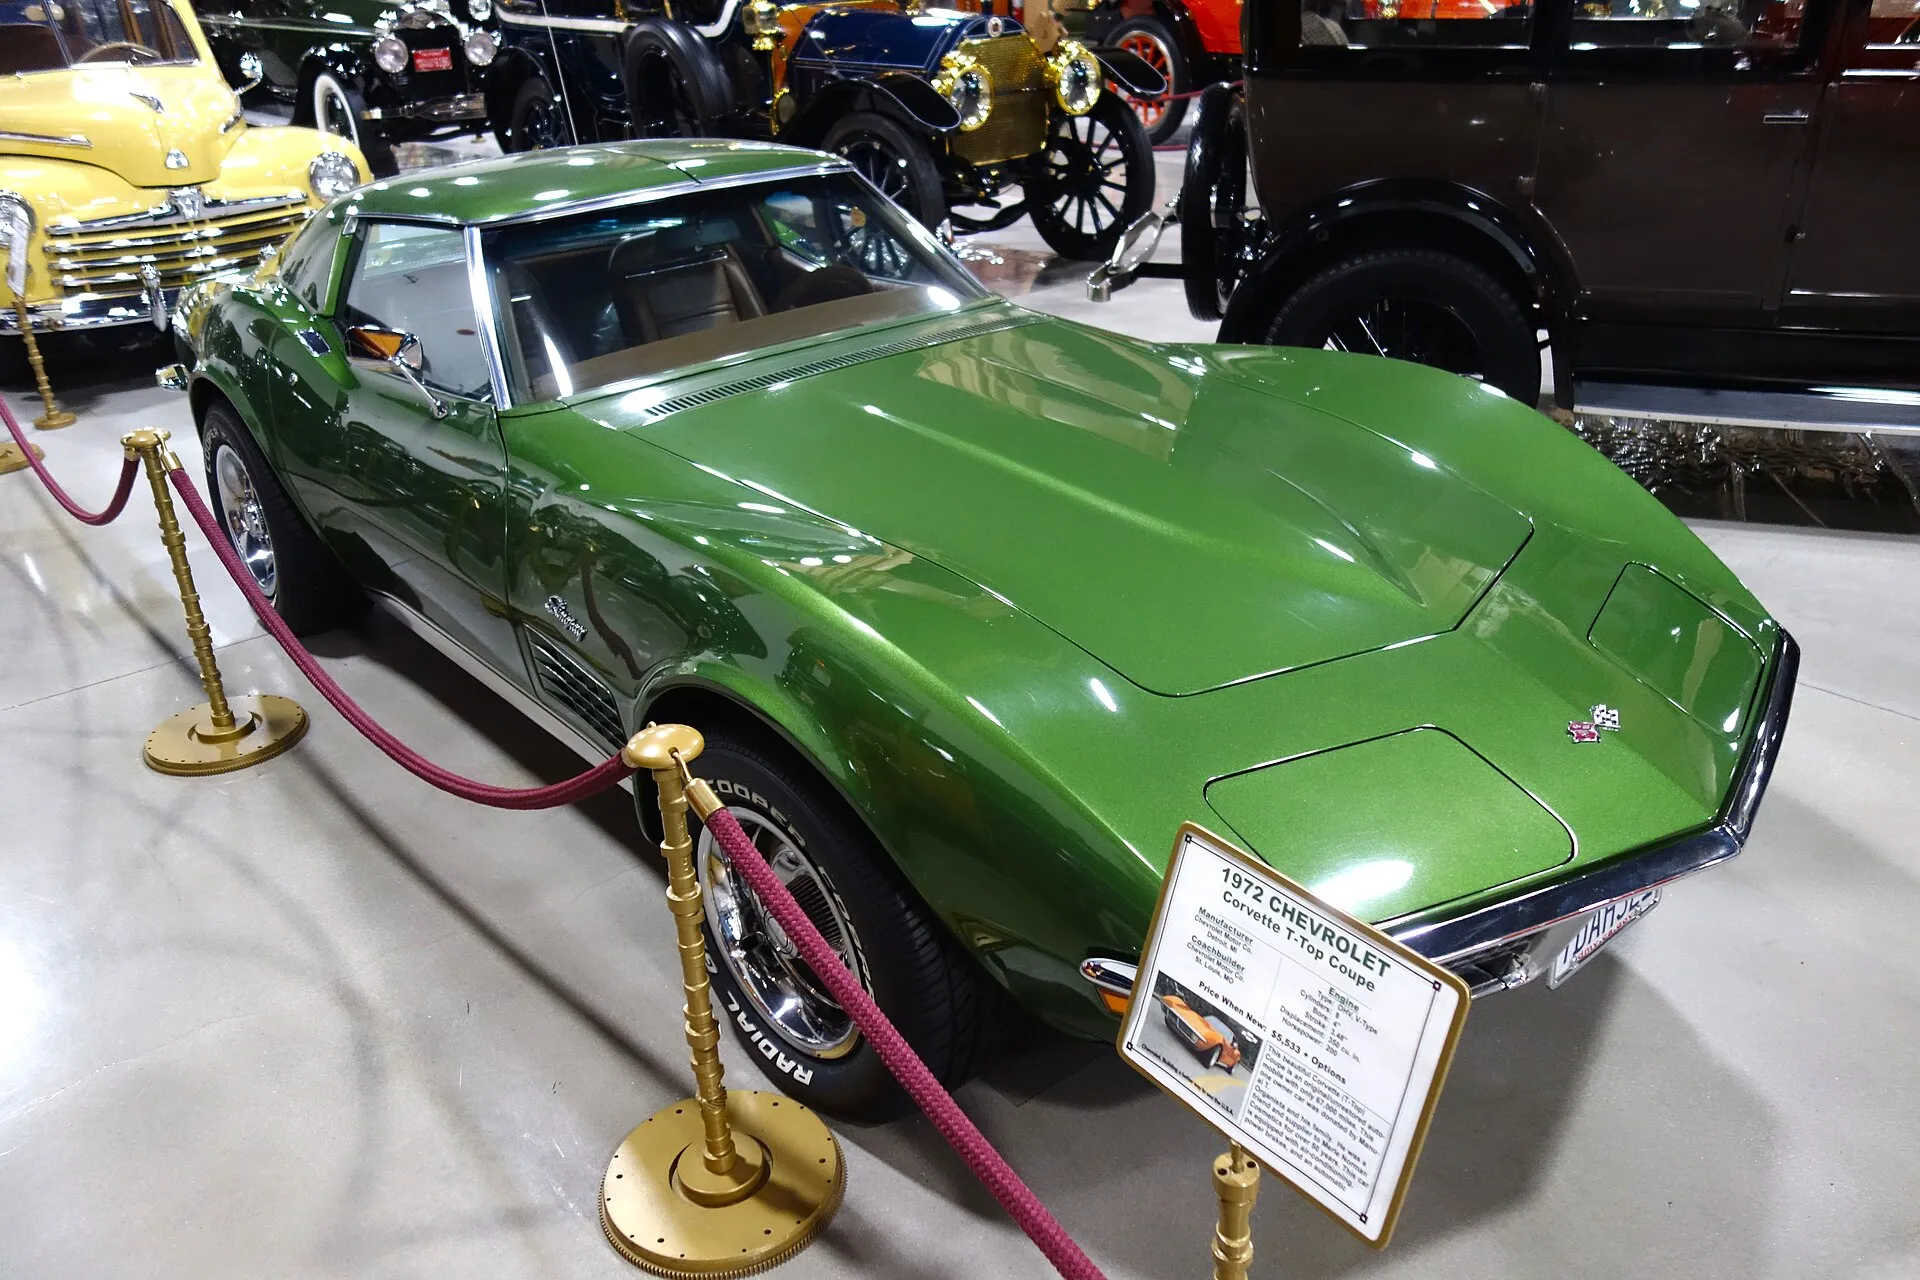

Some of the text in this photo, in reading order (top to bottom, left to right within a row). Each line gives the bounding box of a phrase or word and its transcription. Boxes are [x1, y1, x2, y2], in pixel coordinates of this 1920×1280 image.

[1194, 914, 1223, 936] Chevrolet
[1223, 931, 1241, 946] Motor
[1198, 906, 1253, 944] Manufacturer
[1221, 866, 1391, 977] 1972 CHEVROLET
[1222, 890, 1375, 992] Corvette T-Top Coupe
[1186, 941, 1215, 964] Chevrolet
[1215, 959, 1233, 974] Motor
[1191, 934, 1245, 972] Coachbuilder
[1328, 986, 1359, 1012] Engine
[1354, 1014, 1378, 1035] V-Type
[727, 990, 814, 1086] RADIAL
[1198, 980, 1220, 999] Price
[1221, 995, 1244, 1016] When
[1245, 1011, 1267, 1032] New:
[1270, 1029, 1301, 1054] $5,533
[1310, 1055, 1346, 1085] Options
[1325, 1044, 1338, 1057] 200
[1327, 1036, 1340, 1048] 350
[1264, 1052, 1285, 1071] Coupe
[1268, 1044, 1281, 1058] This
[1282, 1054, 1311, 1078] beautiful
[1311, 1074, 1340, 1098] Corvette
[1259, 1069, 1272, 1081] one
[1272, 1078, 1293, 1095] owner
[1306, 1100, 1319, 1113] was
[1320, 1110, 1348, 1133] donated
[1262, 1061, 1284, 1080] mobile
[1284, 1076, 1299, 1089] with
[1299, 1086, 1315, 1101] only
[1359, 1126, 1374, 1142] This
[1244, 1116, 1264, 1133] power
[1289, 1147, 1303, 1160] and
[1313, 1164, 1346, 1192] automatic
[1249, 1099, 1282, 1127] Cosmetics
[1294, 1131, 1310, 1145] over
[1342, 1164, 1356, 1179] This
[1251, 1092, 1271, 1109] friend
[1271, 1106, 1284, 1118] and
[1284, 1115, 1313, 1138] supplier
[1341, 1153, 1367, 1177] Norman
[1253, 1113, 1284, 1138] equipped
[1284, 1134, 1299, 1148] with
[1286, 1106, 1300, 1119] and
[1347, 1149, 1360, 1162] was
